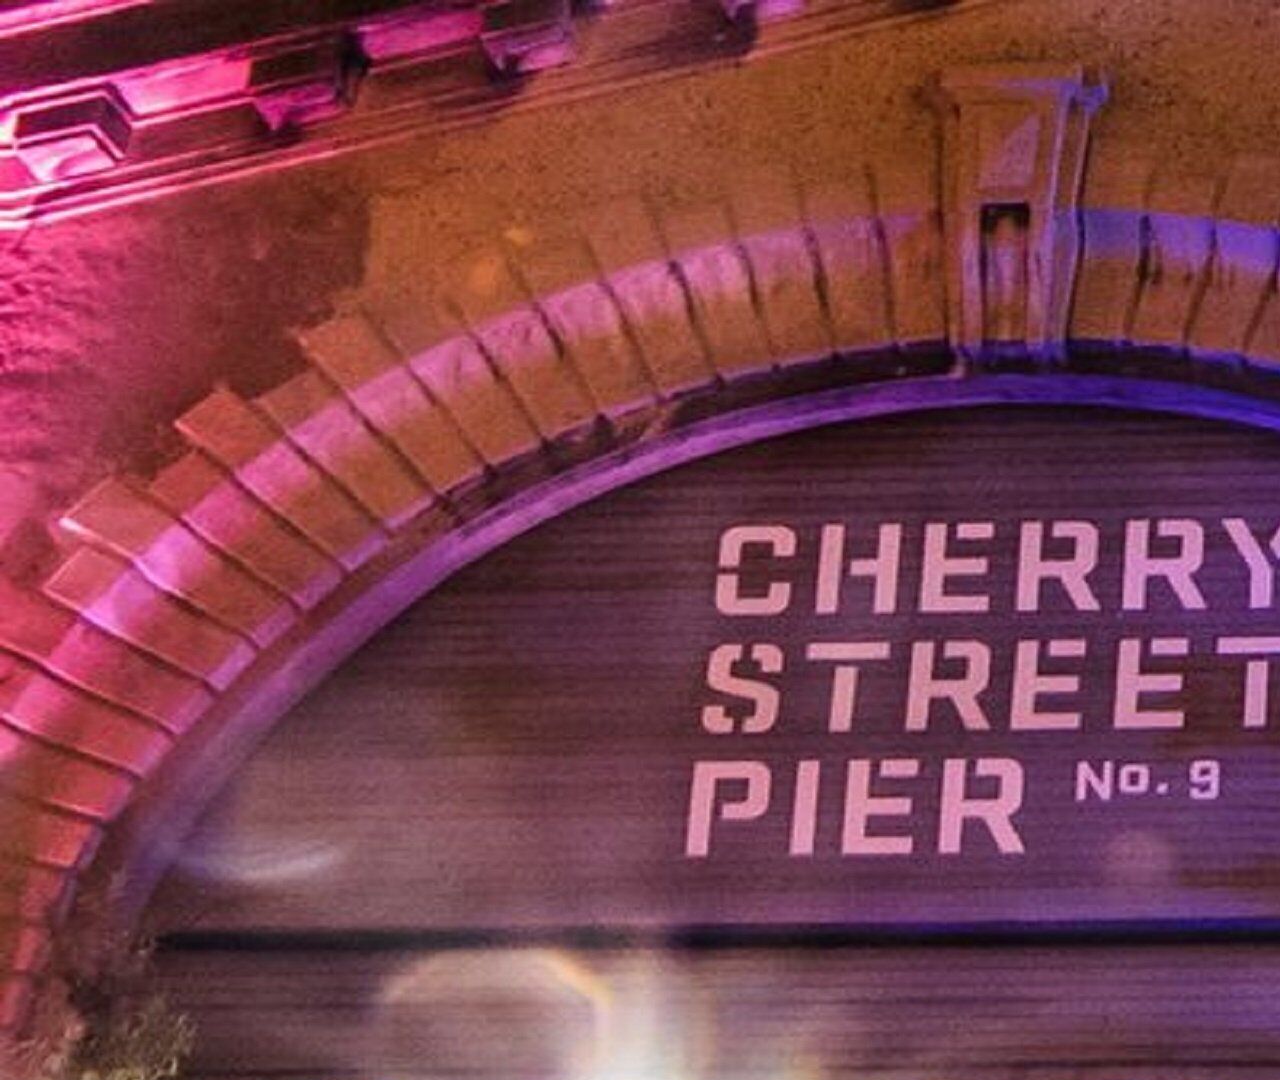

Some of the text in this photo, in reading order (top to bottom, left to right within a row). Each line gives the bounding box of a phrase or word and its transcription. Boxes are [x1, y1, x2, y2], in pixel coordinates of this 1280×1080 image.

[685, 757, 1221, 857] PIER No. 9
